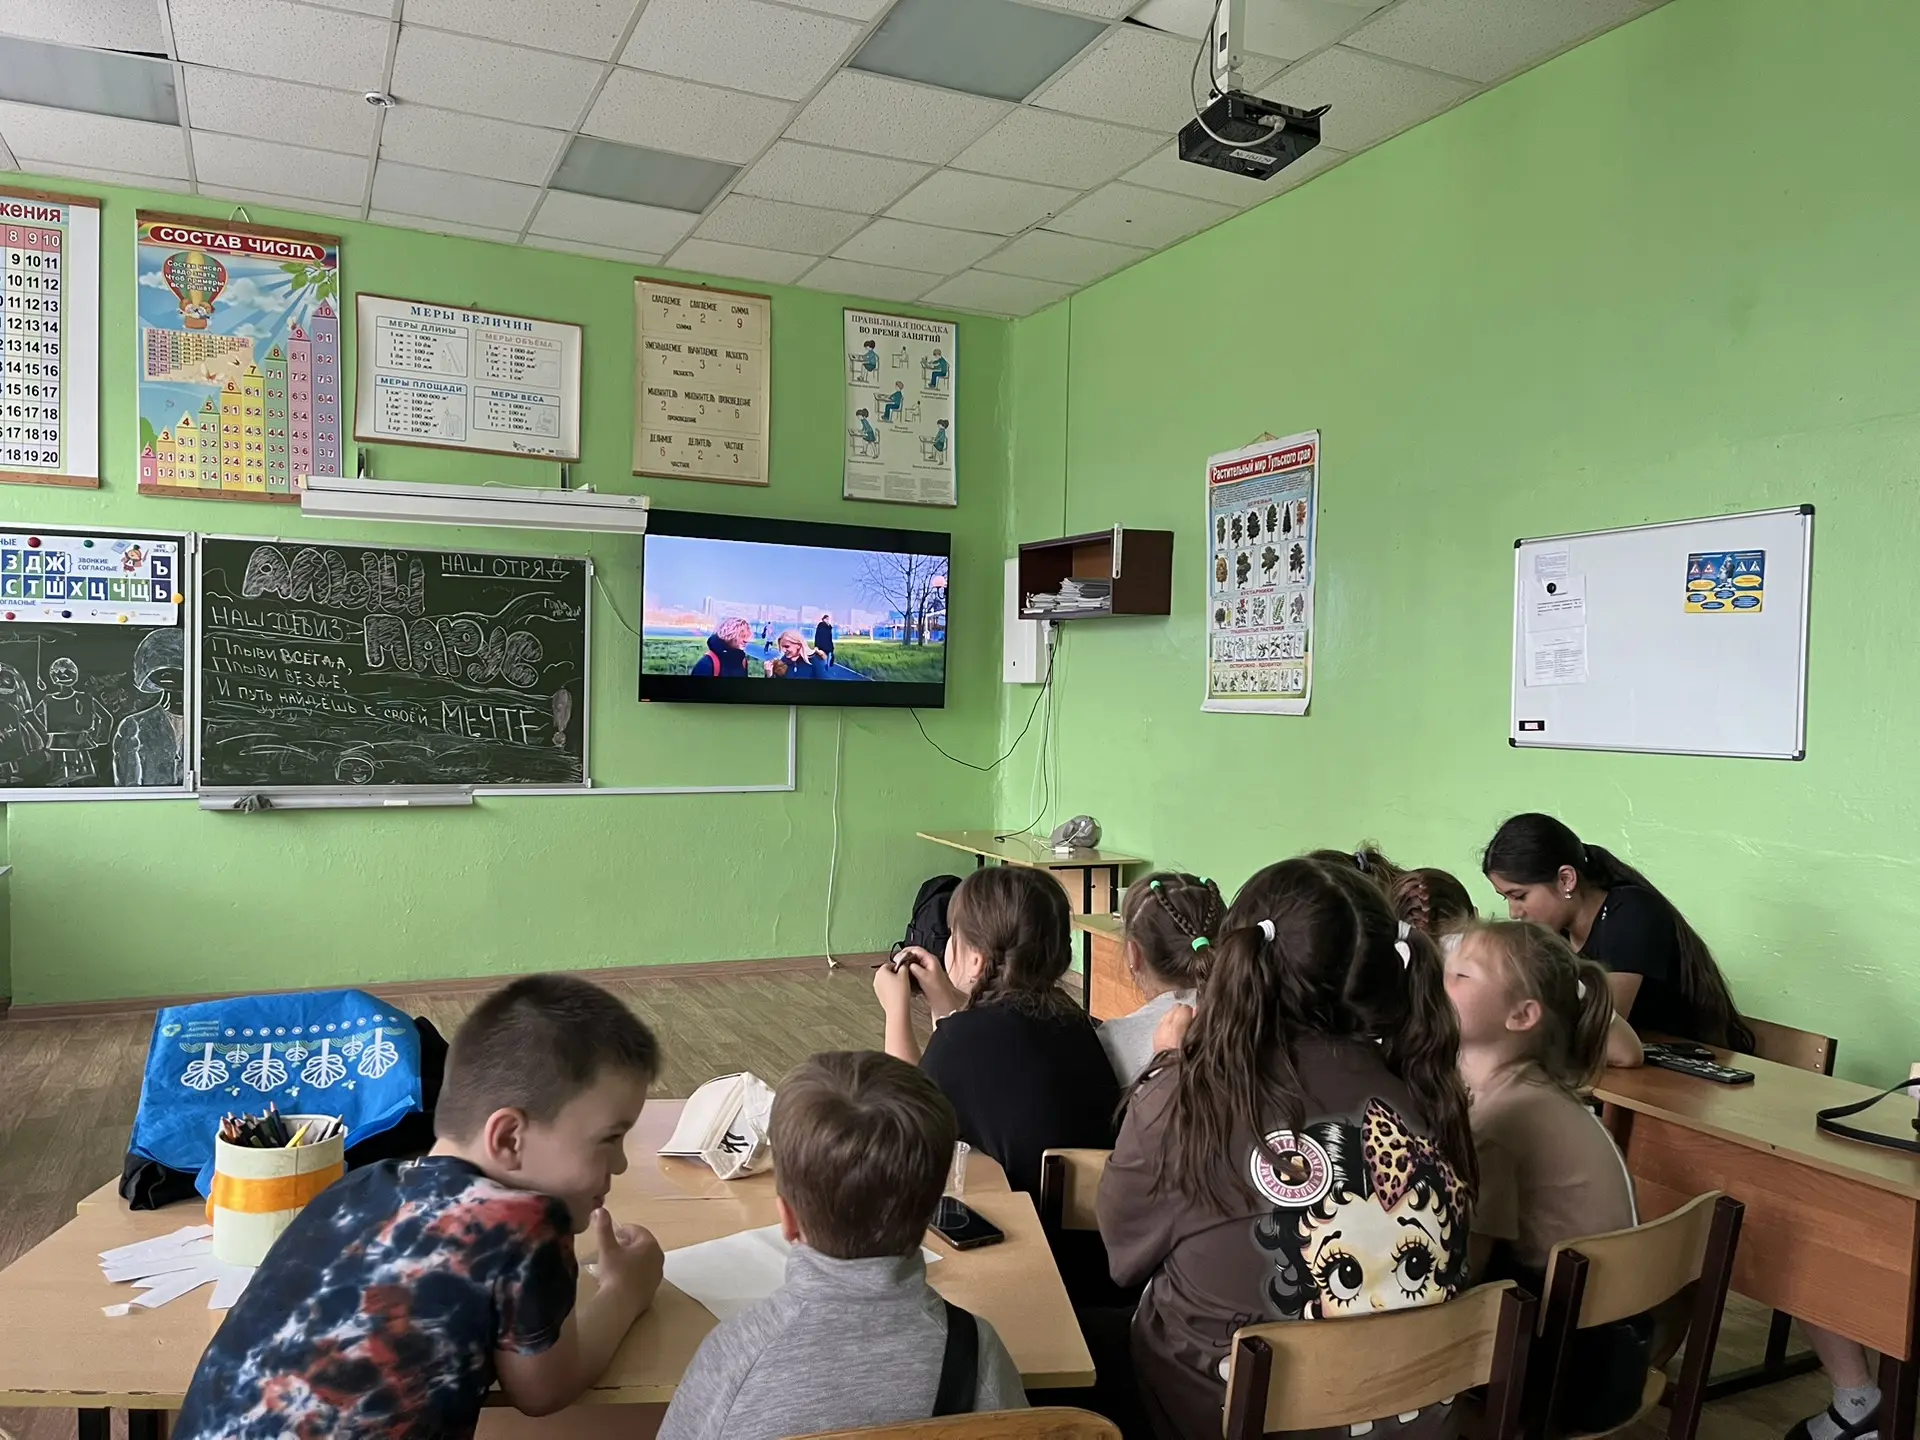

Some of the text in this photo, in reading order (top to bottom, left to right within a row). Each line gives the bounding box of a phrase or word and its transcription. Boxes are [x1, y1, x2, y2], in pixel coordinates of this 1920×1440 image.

[9, 230, 60, 247] 8 9 10
[160, 228, 315, 259] СОСТАВ ЧИСЛА
[11, 253, 57, 269] 9 10 11
[167, 260, 197, 269] Состав
[7, 274, 59, 291] 10 11 12
[8, 296, 58, 312] 11 12 13
[319, 307, 331, 316] 10
[652, 294, 750, 315] СЛАГАЕМОЕ СЛАГАЕМОЕ СУММА
[7, 317, 58, 333] 12 13 14
[411, 306, 532, 331] МЕРЫ ВЕЛИЧИН
[663, 308, 743, 328] 7 2 9
[851, 315, 948, 334] ПРАВИЛЬНАЯ ПОСАДКА
[296, 329, 303, 338] 9
[389, 320, 456, 334] МЕРЫ ДЛИНЫ
[676, 323, 692, 331] СУММА
[859, 326, 941, 343] ВО ВРЕМЯ ЗАНЯТИЙ
[485, 333, 513, 342] МЕРЫ
[7, 339, 59, 355] 13 14 15
[273, 349, 280, 357] 8
[6, 361, 59, 377] 14 15 16
[250, 365, 257, 374] 7
[661, 355, 742, 374] 7 3 4
[6, 383, 58, 399] 15 16 17
[227, 382, 235, 391] 6
[381, 377, 462, 392] МЕРЫ ПЛОЩАДИ
[491, 390, 544, 403] МЕРЫ ВЕСА
[6, 405, 58, 420] 16 17 18
[206, 402, 213, 411] 5
[660, 400, 740, 419] 2 3 6
[182, 417, 190, 426] 4
[6, 427, 58, 442] 17 18 19
[163, 431, 170, 440] 3
[688, 437, 712, 448] ДЕЛИТЕЛЬ
[6, 449, 58, 463] 18 19 20
[144, 447, 152, 456] 2
[660, 446, 739, 464] 6 2 3
[1213, 448, 1311, 480] Растительный мир Тульского края
[6, 554, 168, 575] З Д Ж Ъ
[77, 564, 118, 572] СОГЛАСНЫЕ
[441, 553, 570, 579] НАШ ОТРЯД
[6, 579, 167, 601] С Т Ш Х Ц Ч Щ Ь
[212, 606, 264, 626] НАШ
[363, 614, 544, 688] ПАРУС
[216, 676, 230, 697] И
